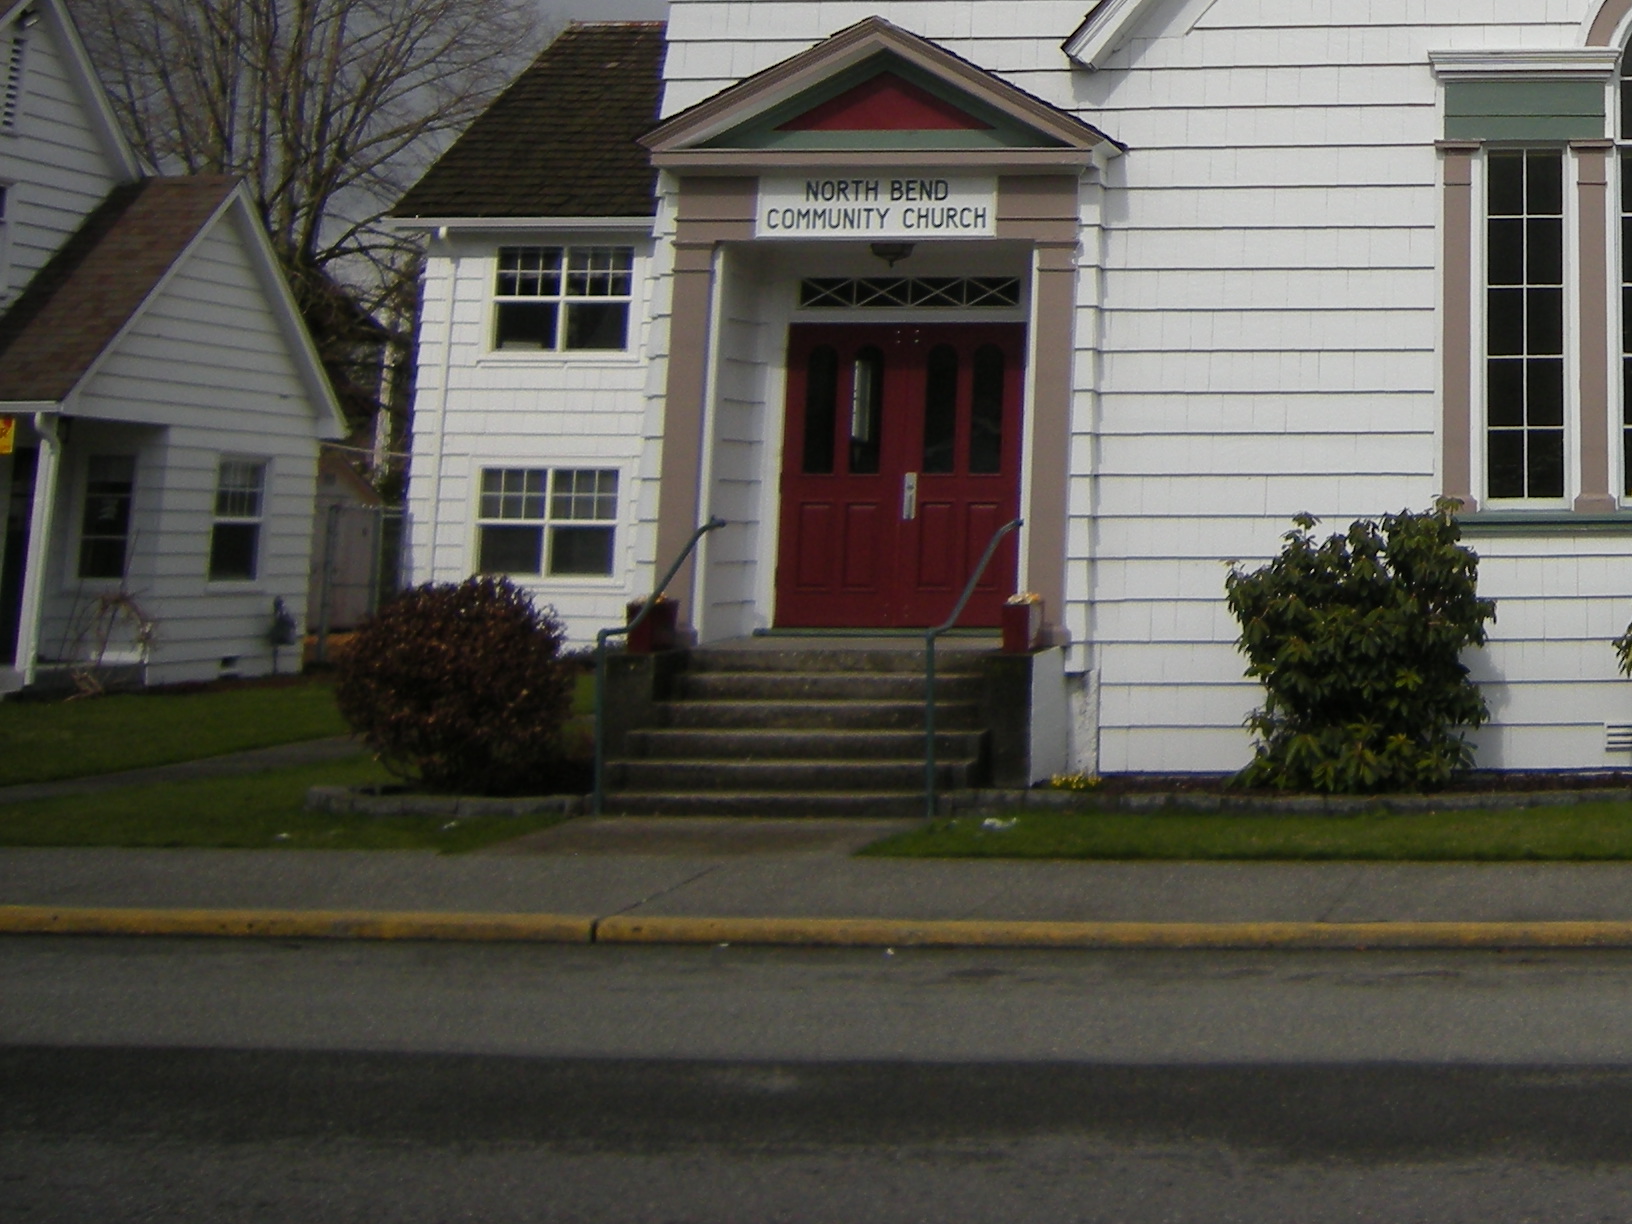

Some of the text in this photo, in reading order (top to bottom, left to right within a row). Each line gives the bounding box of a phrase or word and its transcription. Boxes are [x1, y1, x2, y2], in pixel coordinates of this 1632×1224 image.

[806, 180, 948, 202] NORTH BEND
[767, 207, 986, 229] COMMUNITY CHURCH
